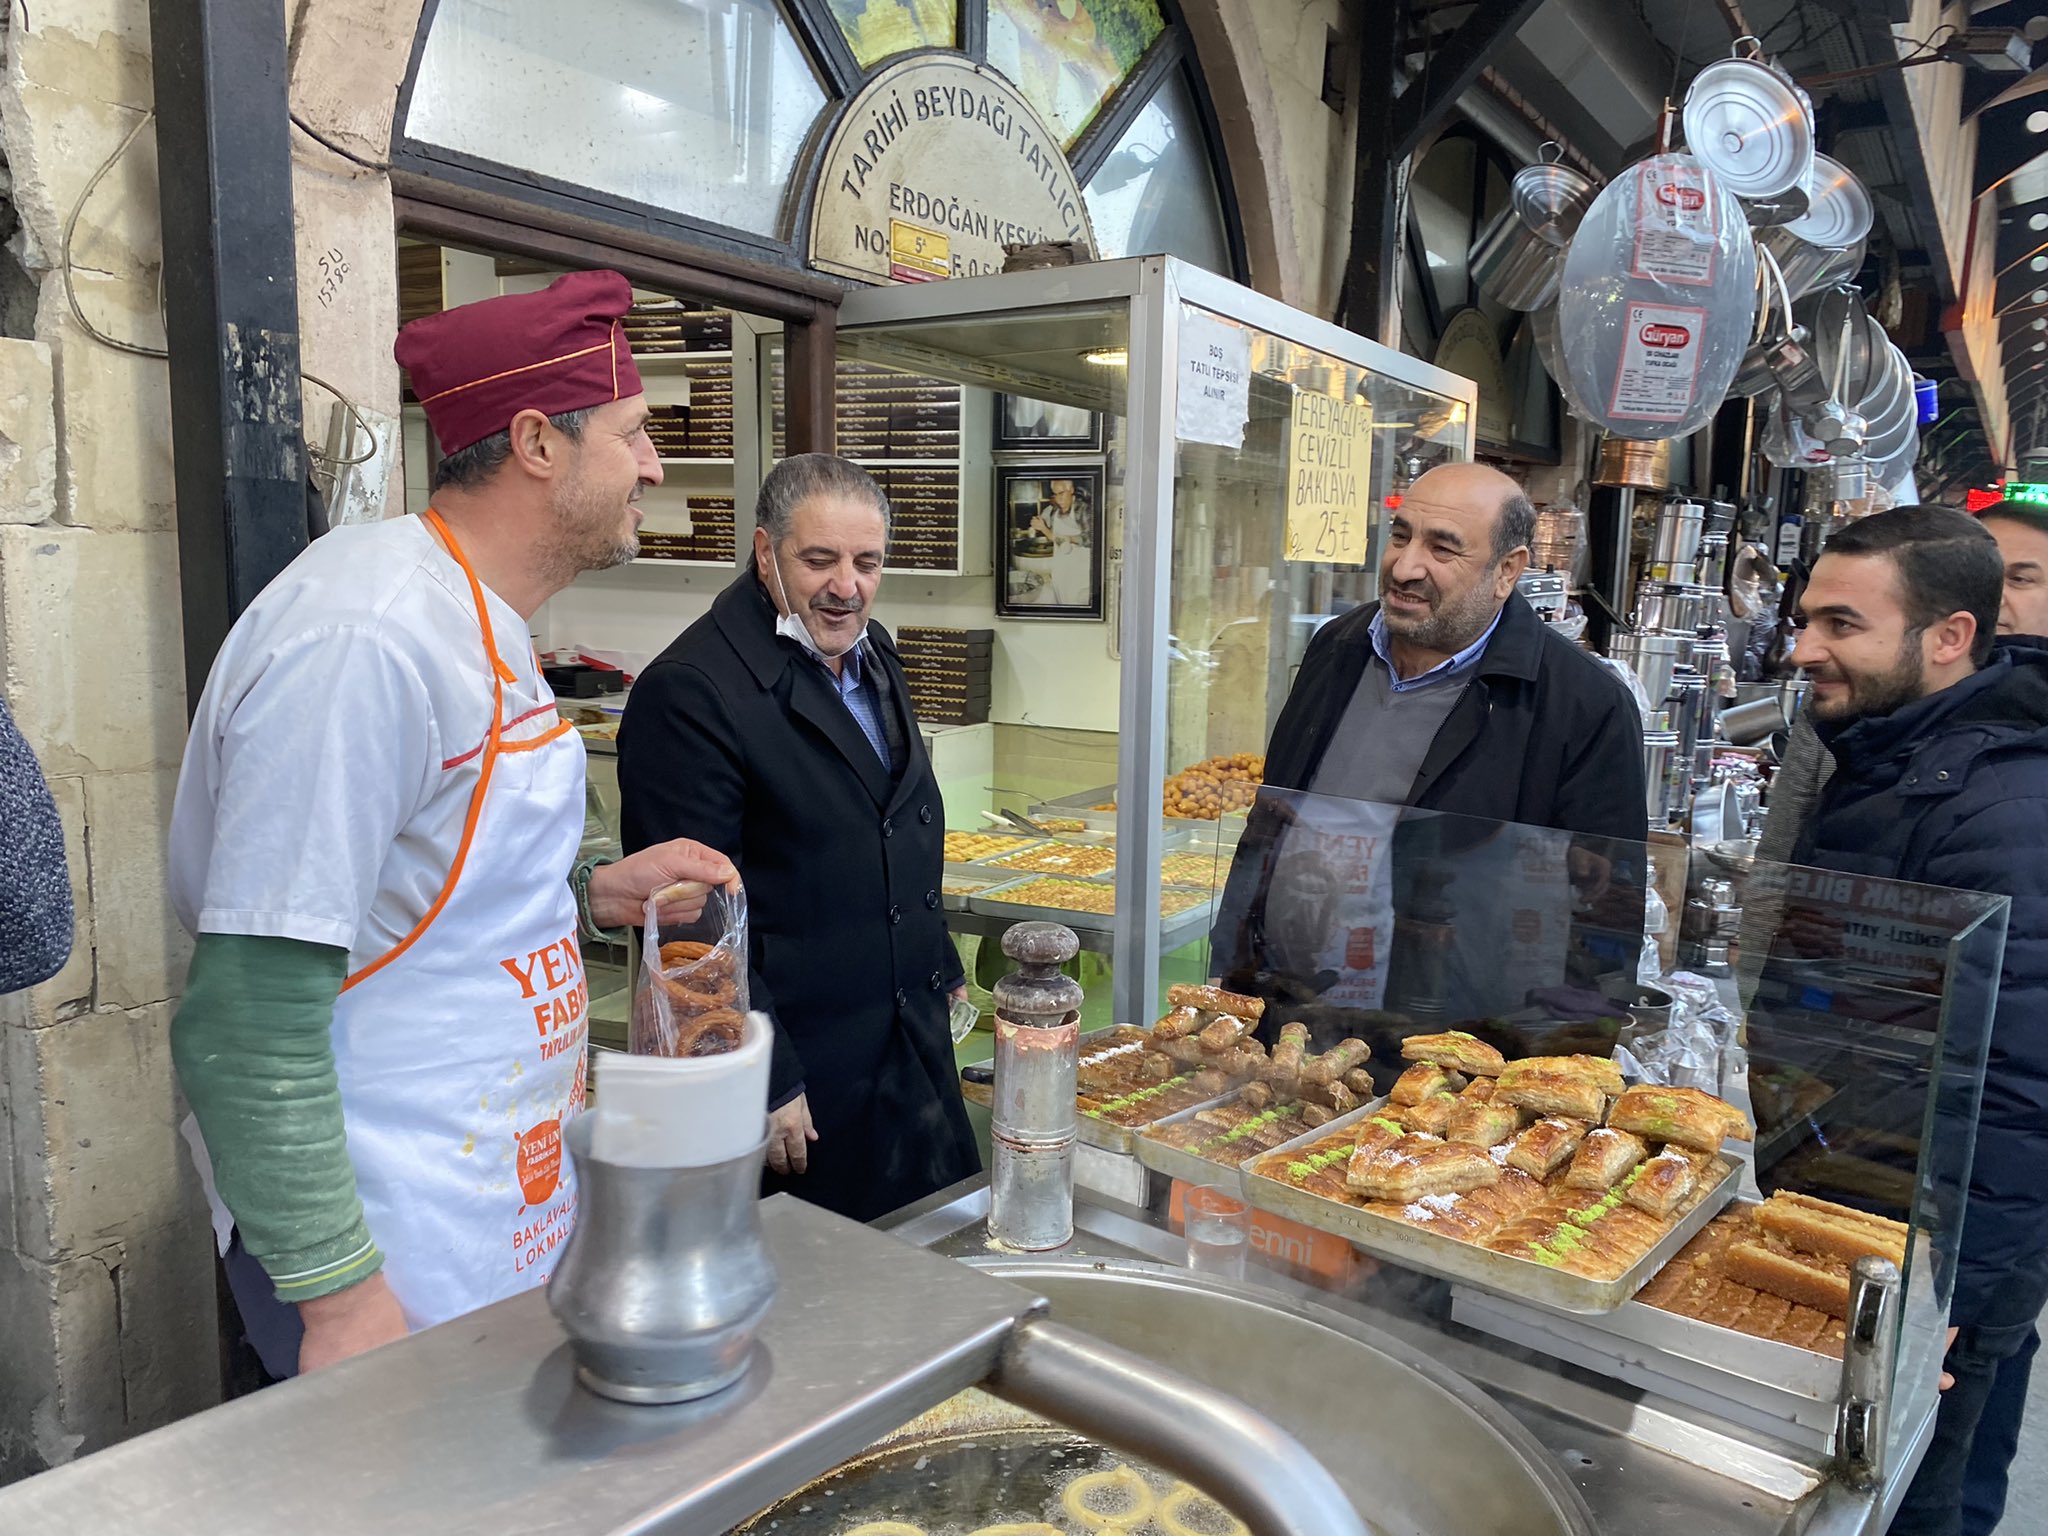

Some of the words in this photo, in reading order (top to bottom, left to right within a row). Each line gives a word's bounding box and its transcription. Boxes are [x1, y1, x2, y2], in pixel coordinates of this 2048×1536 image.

[841, 89, 908, 200] TARİHİ
[914, 85, 1012, 141] BEYDAĞI
[889, 182, 988, 240] ERDOĞAN
[318, 247, 343, 276] SU
[1641, 324, 1685, 347] Güryan
[1298, 433, 1352, 469] CEVİZLİ
[1295, 470, 1357, 507] BAKLAVA
[522, 1132, 547, 1157] YENİ
[1249, 1223, 1314, 1266] enni
